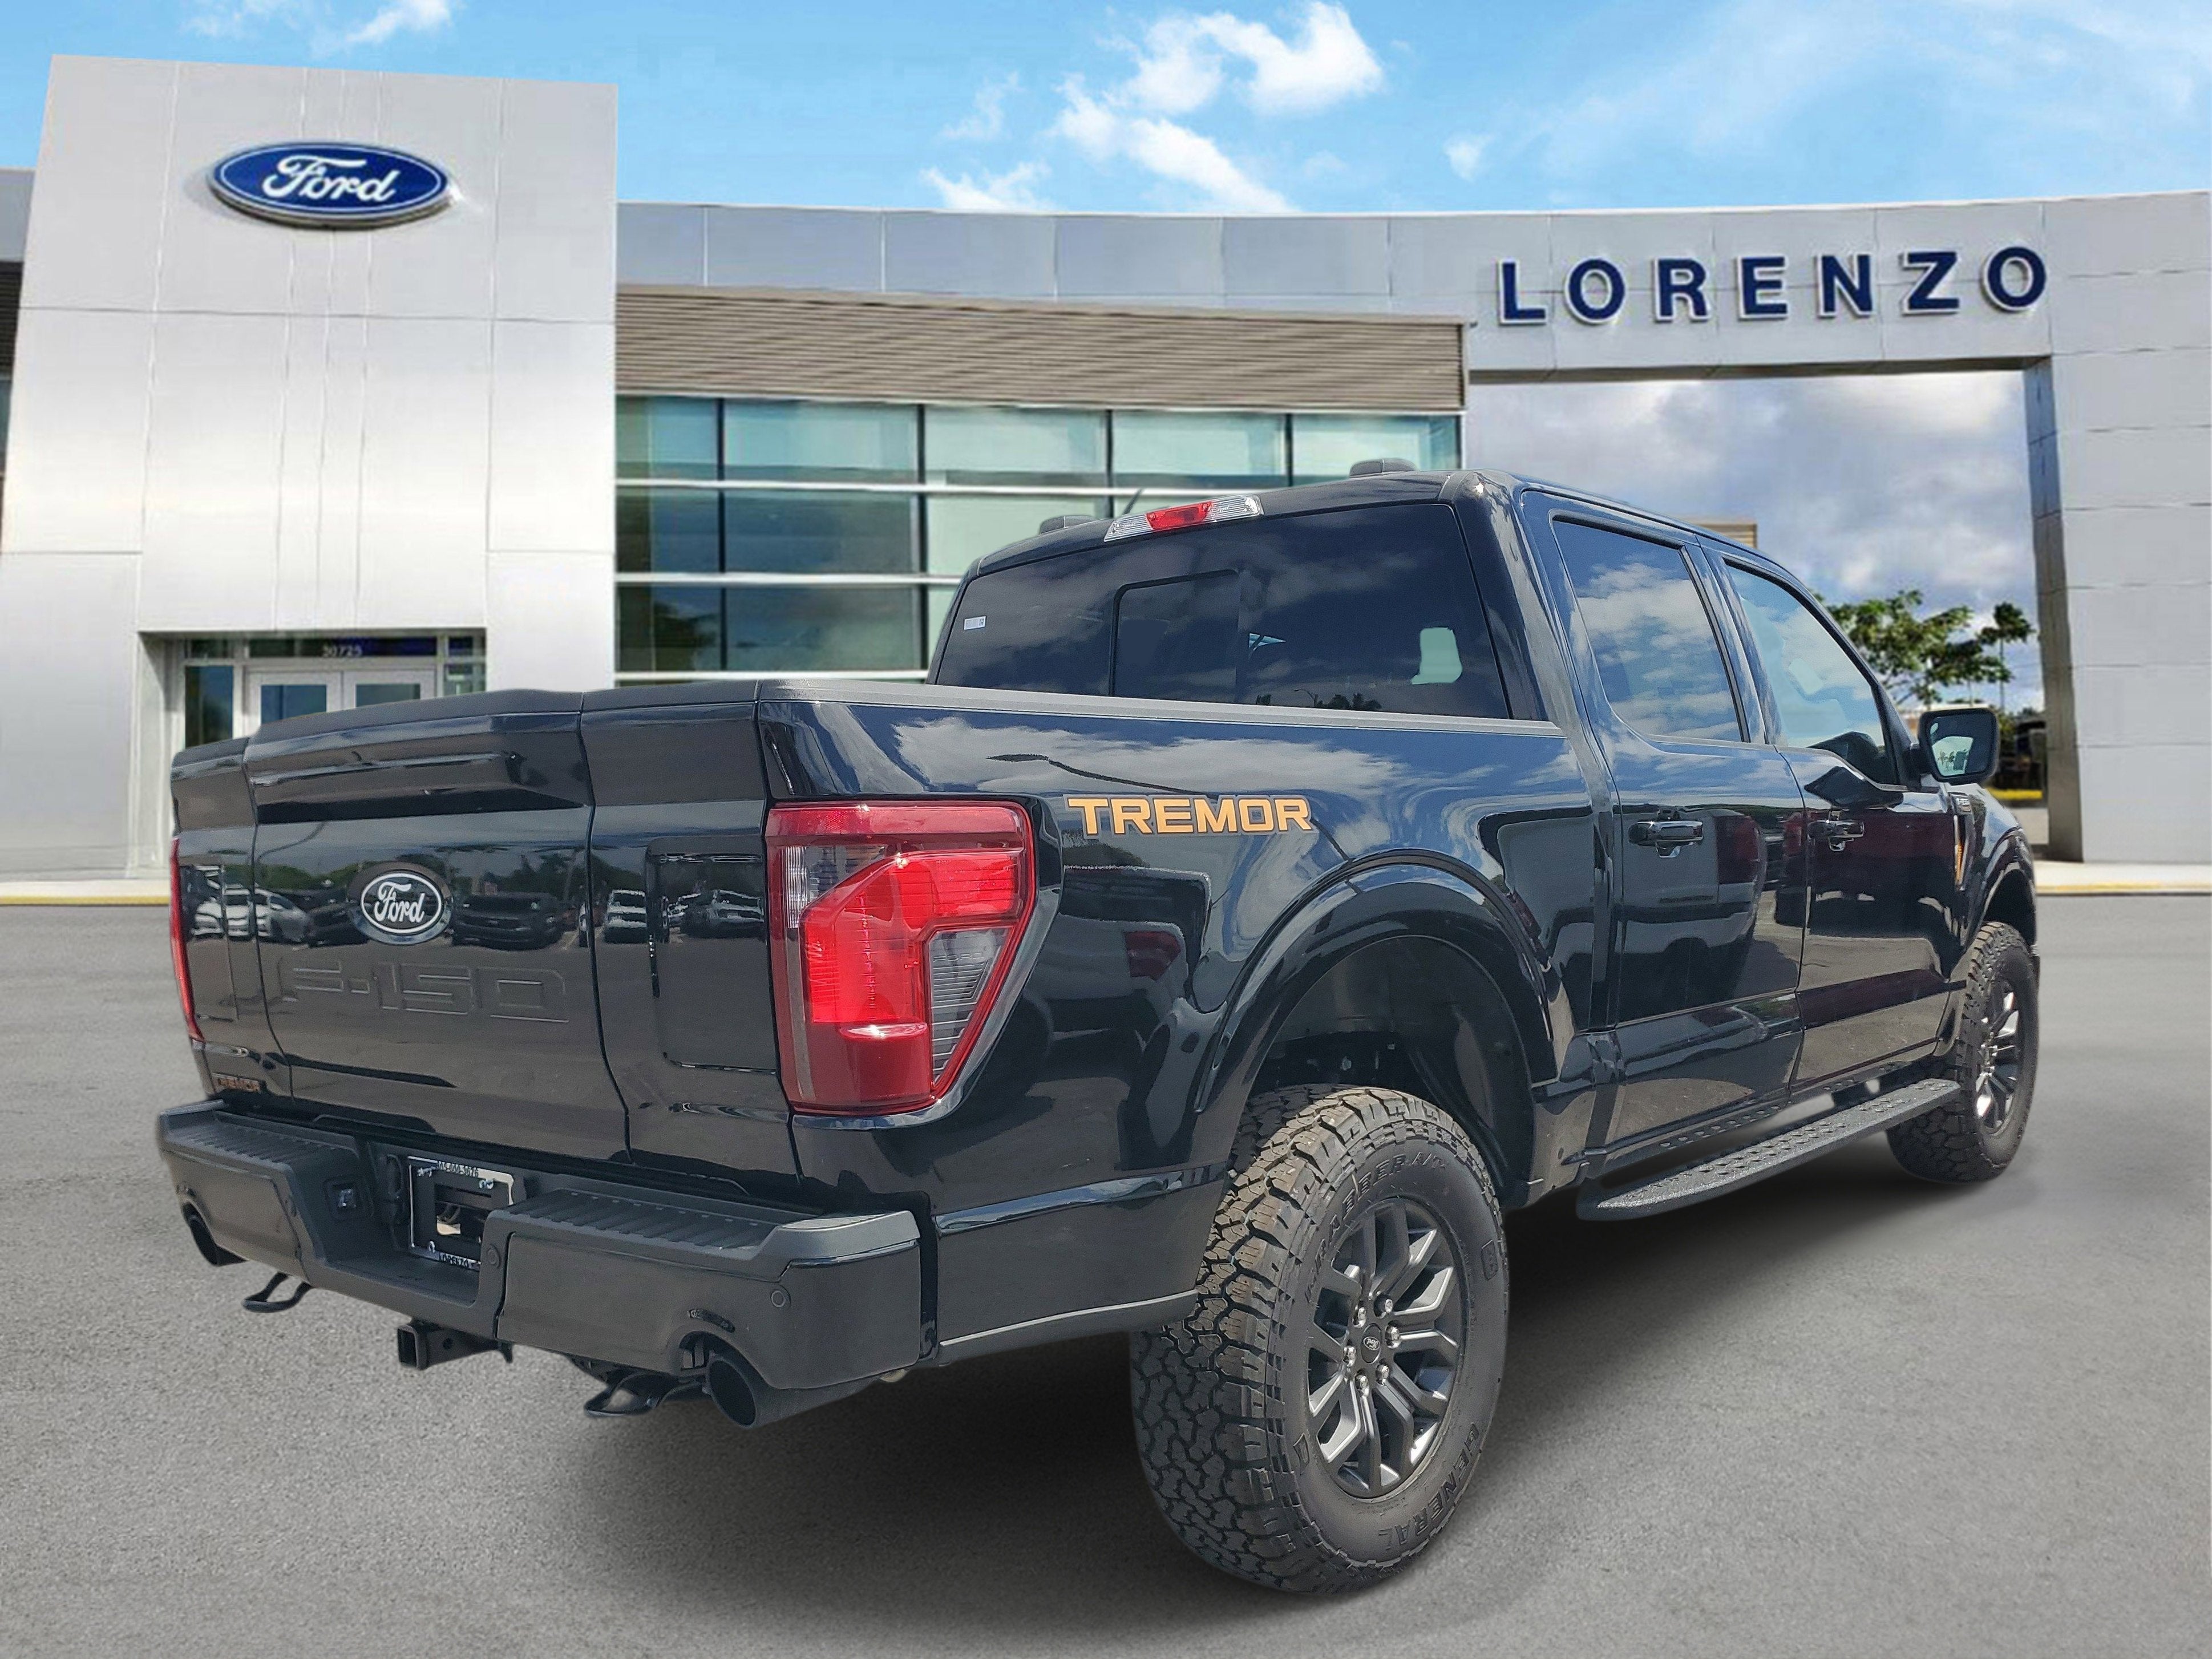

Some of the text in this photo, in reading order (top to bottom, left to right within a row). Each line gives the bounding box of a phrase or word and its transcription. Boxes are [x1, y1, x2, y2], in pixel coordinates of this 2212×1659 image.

[262, 155, 400, 201] Ford
[1498, 246, 2047, 323] LORENZO
[1067, 797, 1313, 835] TREMOR
[374, 881, 425, 922] Ford
[933, 951, 984, 962] FORD
[277, 957, 569, 1023] F-150
[1378, 1422, 1480, 1550] GENERAL
